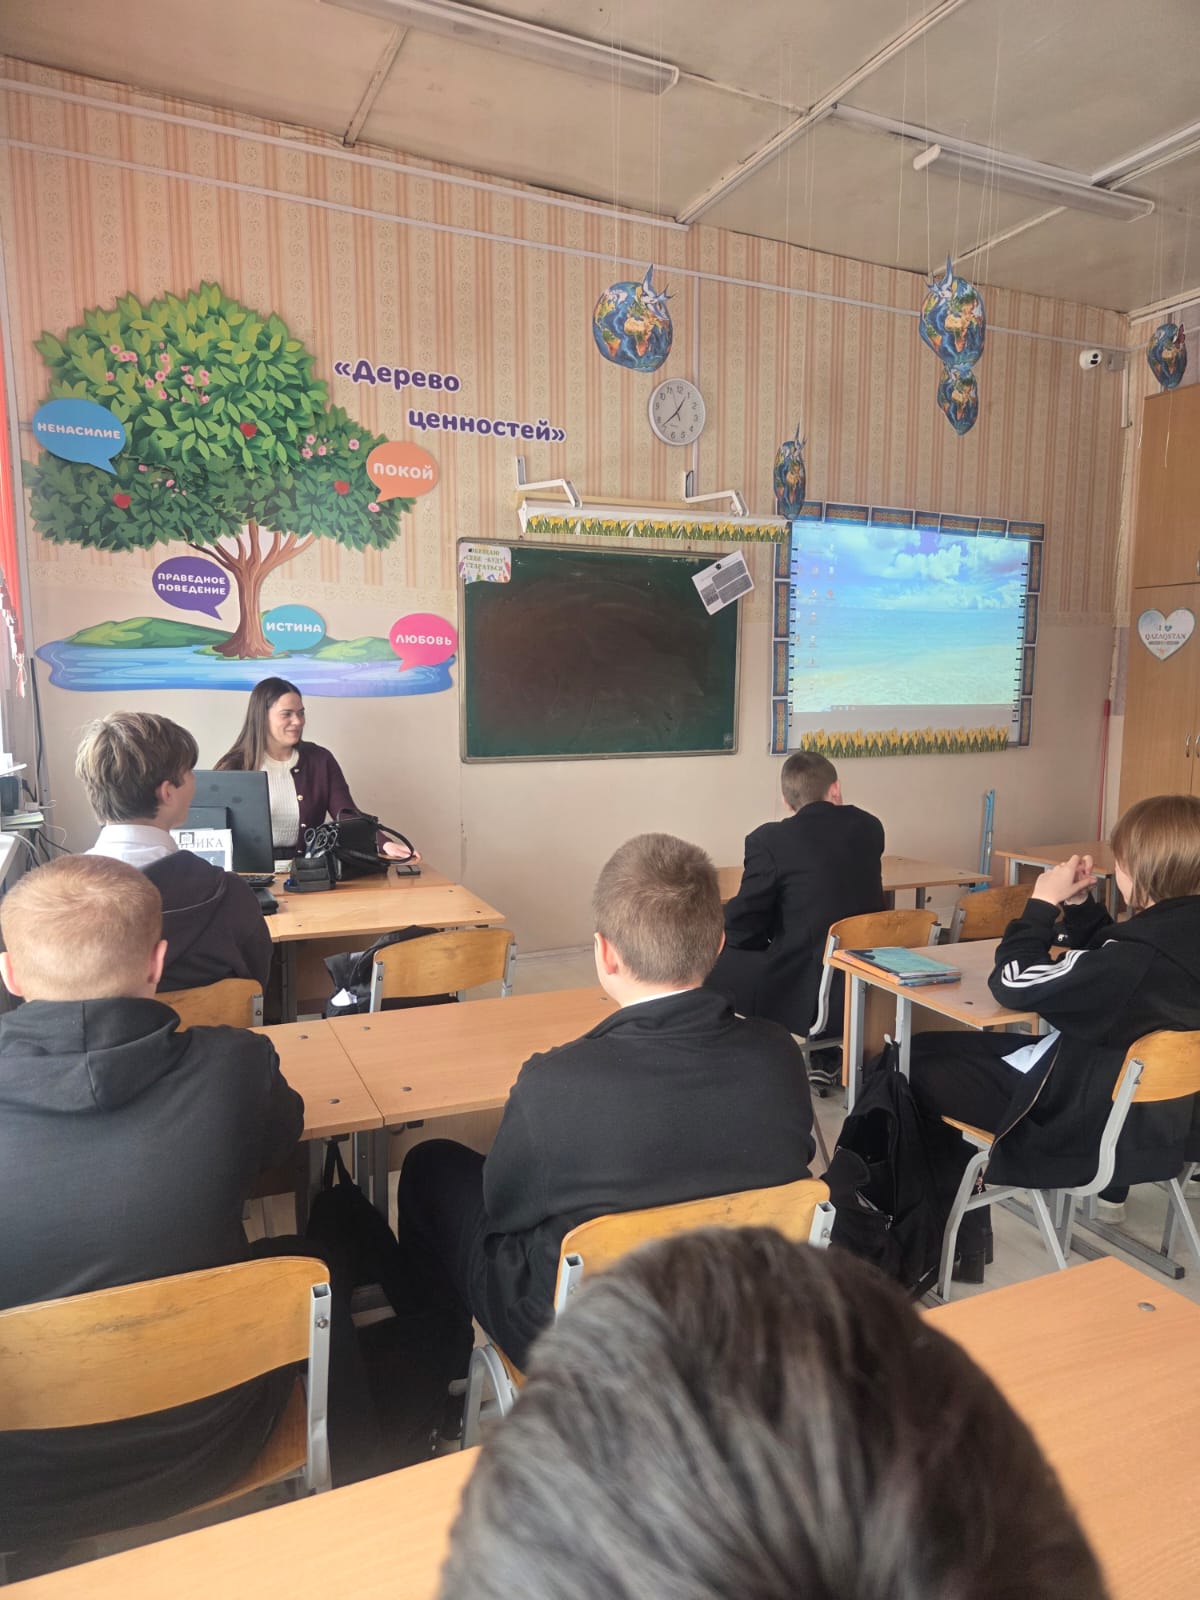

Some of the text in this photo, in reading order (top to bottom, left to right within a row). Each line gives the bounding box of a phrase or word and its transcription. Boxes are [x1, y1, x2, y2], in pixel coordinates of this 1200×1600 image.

[334, 360, 460, 390] «Дерево
[37, 422, 121, 439] НЕНАСИЛИЕ
[409, 410, 565, 441] ценностей»
[373, 462, 433, 480] ПОКОЙ
[158, 573, 226, 584] ПРАВЕДНОЕ
[158, 584, 226, 595] ПОВЕДЕНИЕ
[265, 621, 322, 633] ИСТИНА
[395, 634, 452, 646] ЛЮБОВЬ
